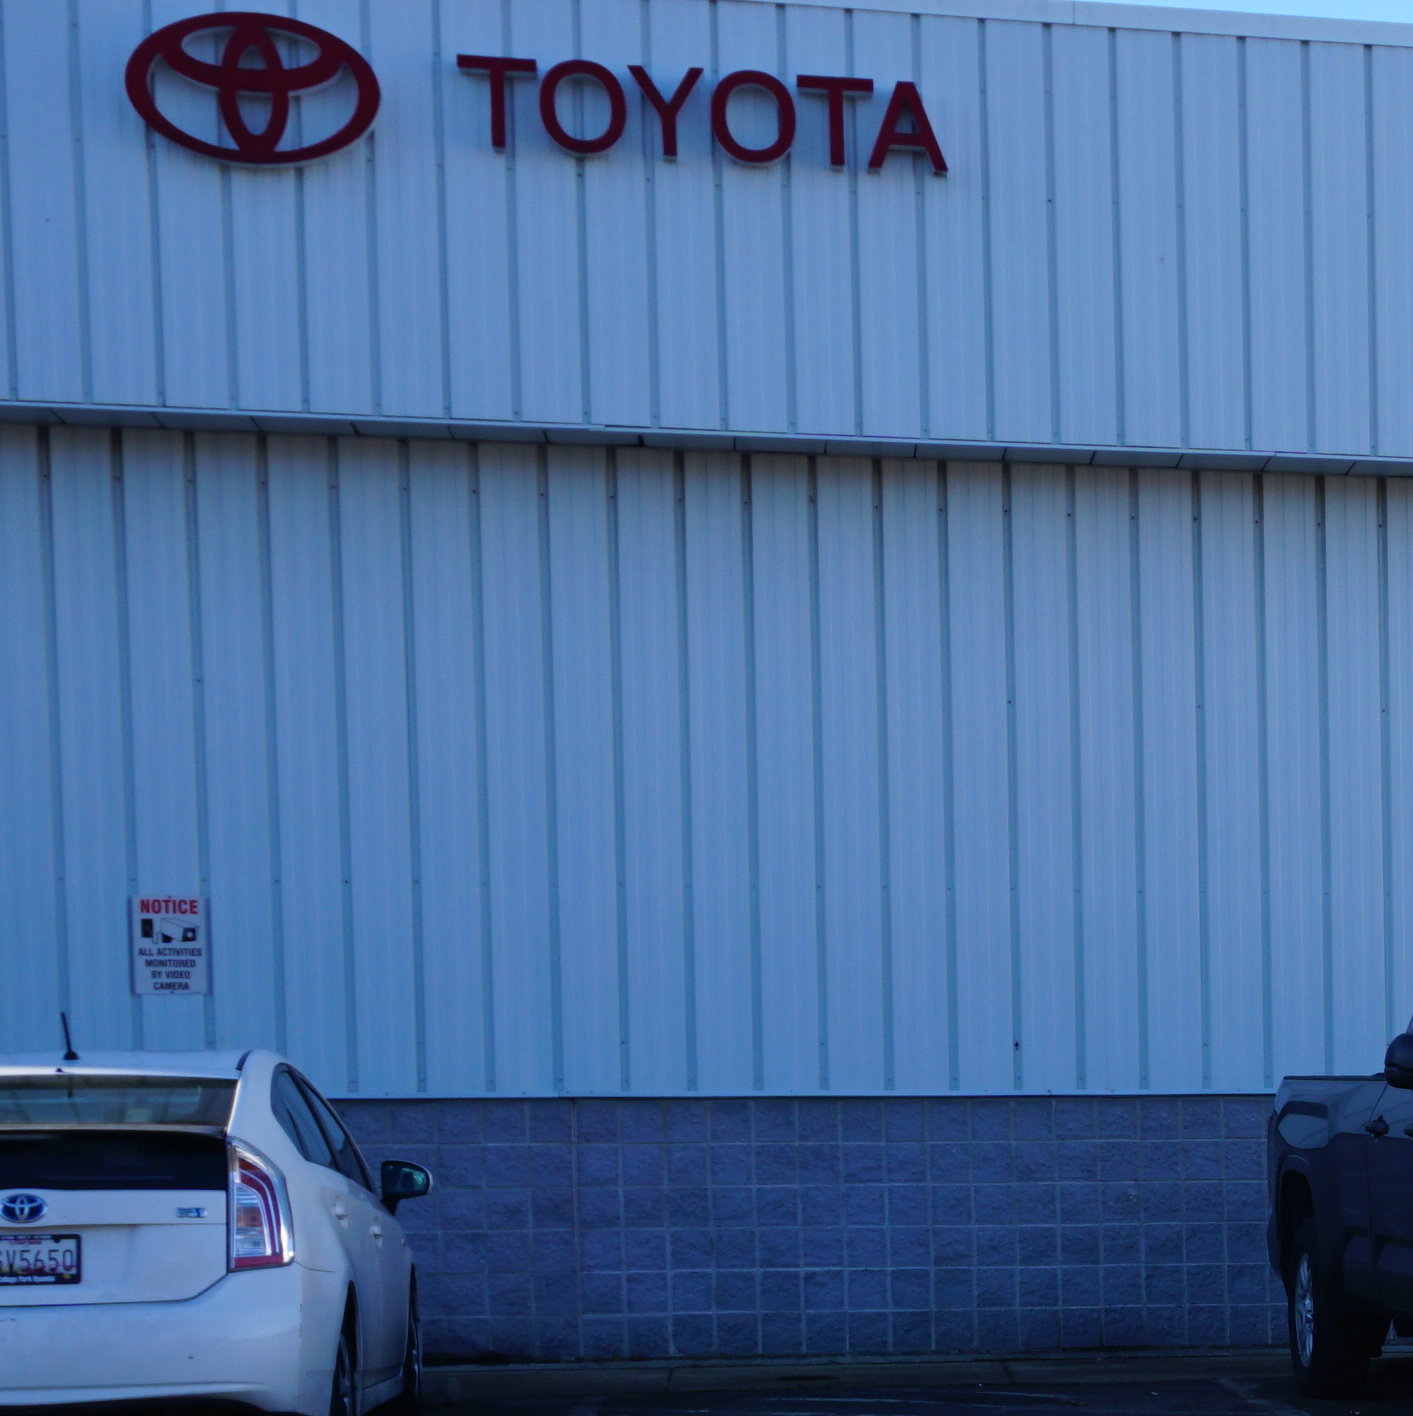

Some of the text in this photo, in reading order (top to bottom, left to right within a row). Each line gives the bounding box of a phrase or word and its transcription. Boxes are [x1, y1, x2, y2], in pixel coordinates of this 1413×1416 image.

[456, 54, 949, 175] TOYOTA
[140, 899, 198, 914] NOTICE
[138, 948, 202, 956] ALL ACTIVITIES
[145, 959, 196, 967] MONITORED
[151, 970, 190, 979] BY VIDEO
[153, 982, 189, 990] CAMERA
[0, 1249, 74, 1271] V5650
